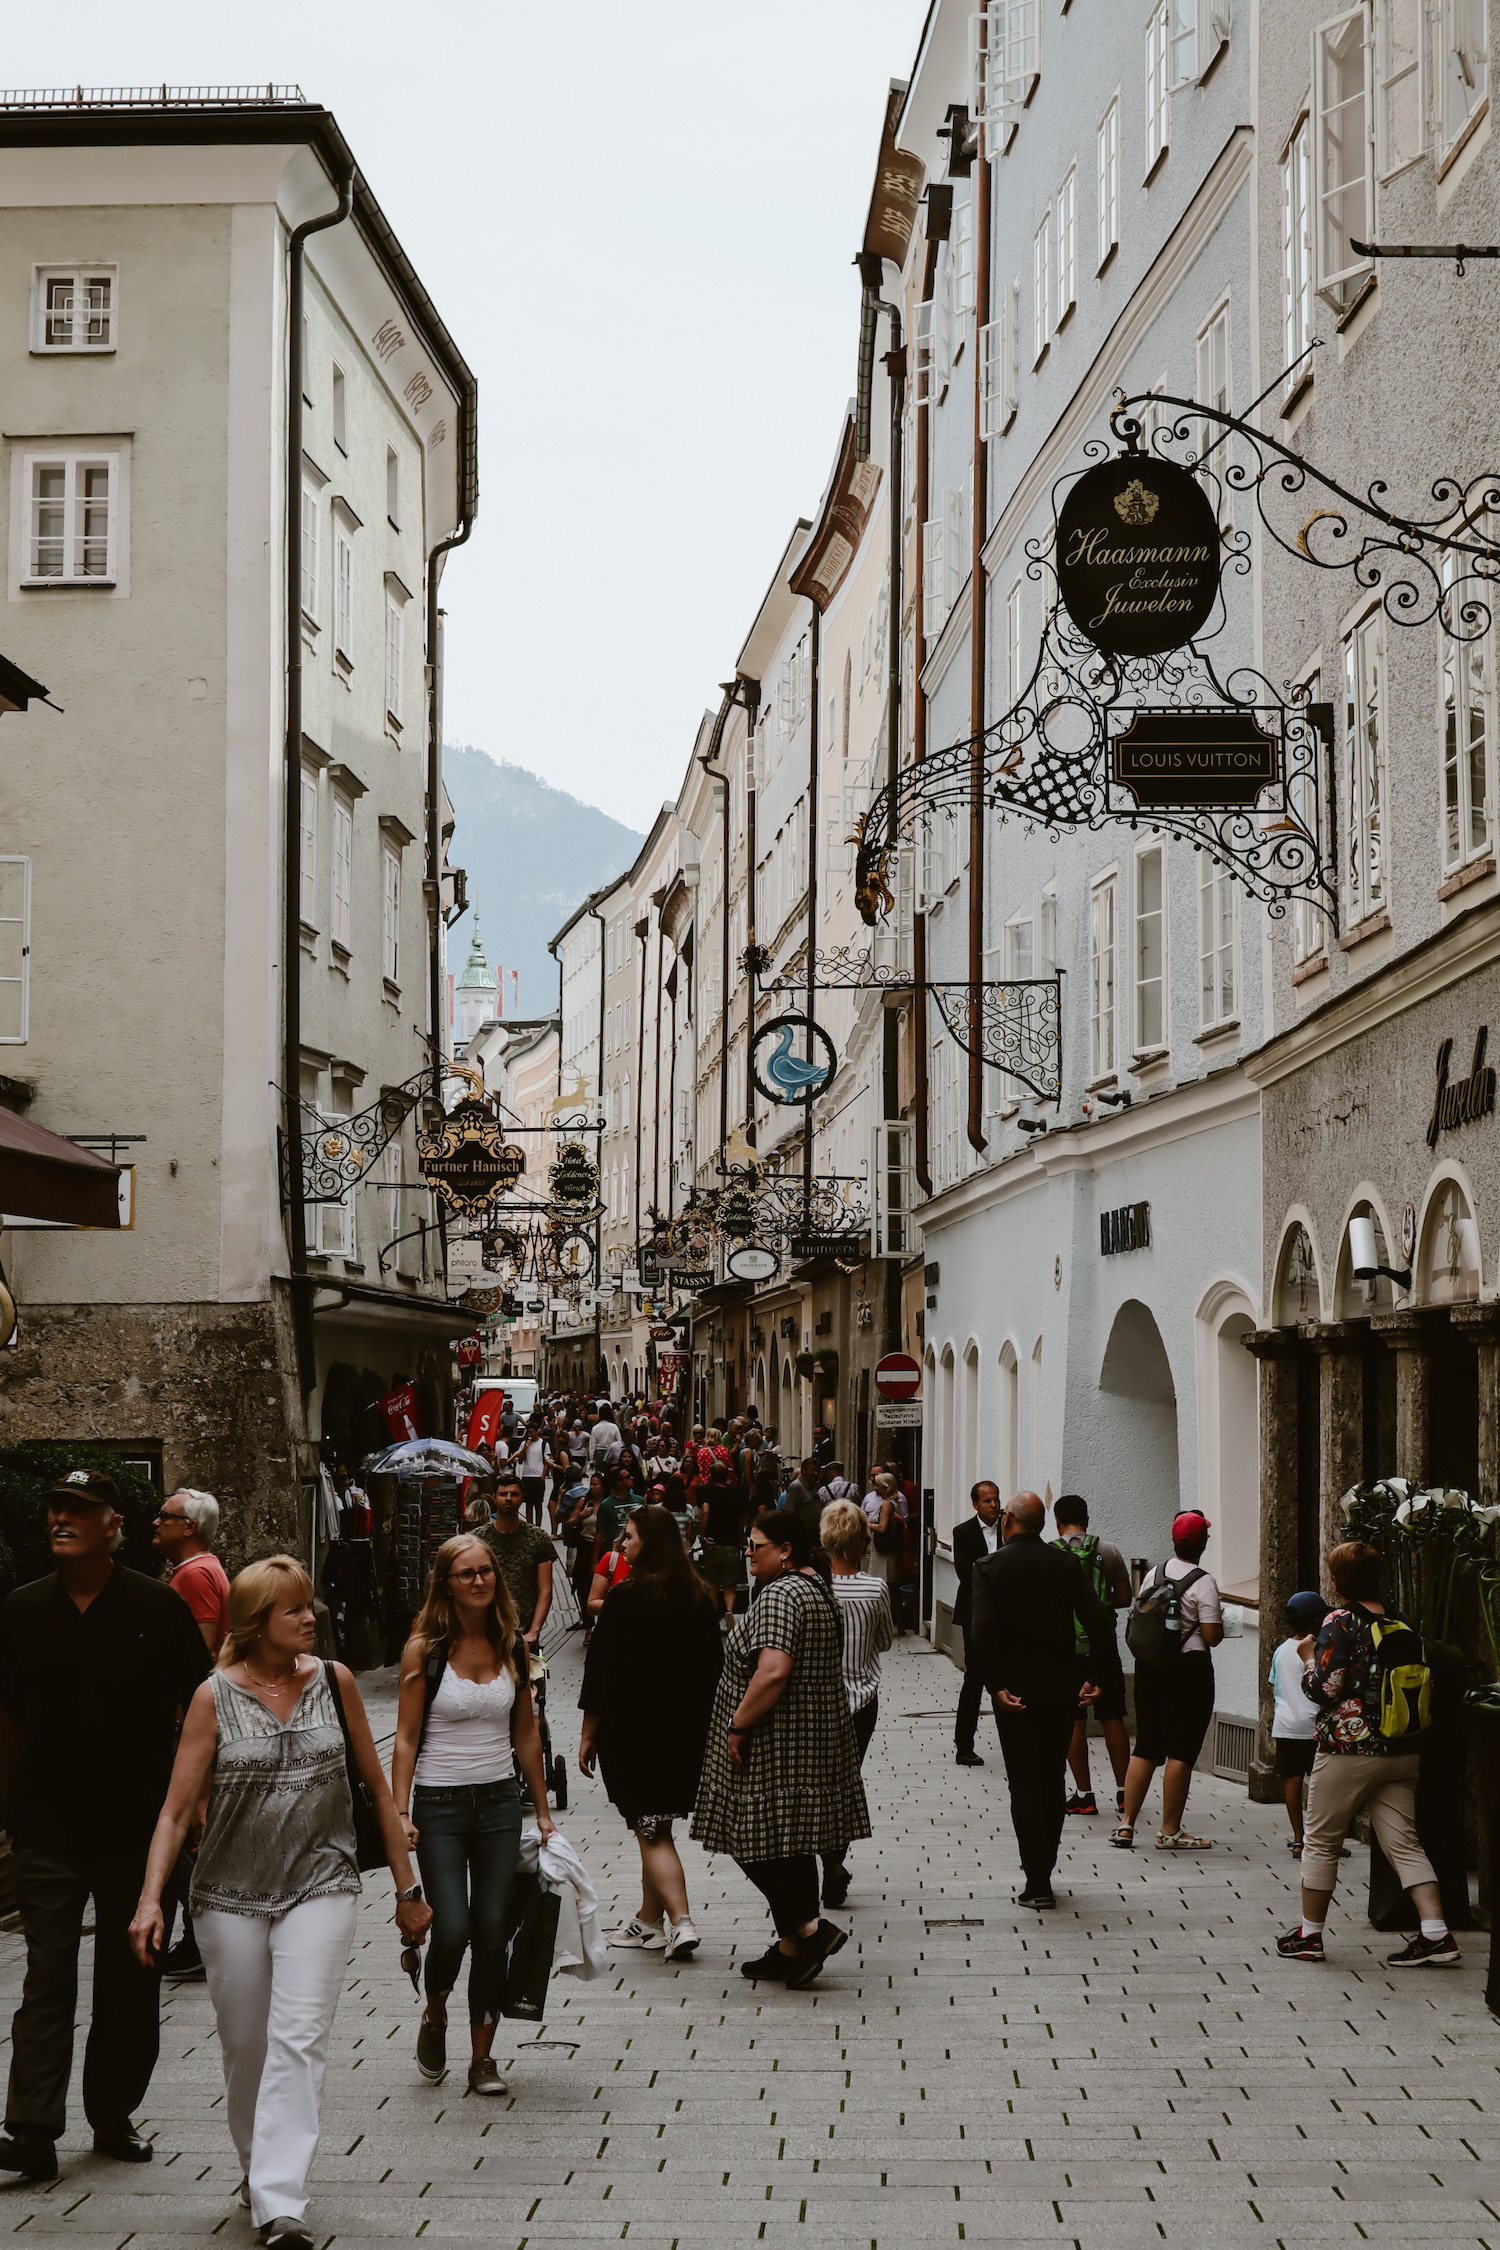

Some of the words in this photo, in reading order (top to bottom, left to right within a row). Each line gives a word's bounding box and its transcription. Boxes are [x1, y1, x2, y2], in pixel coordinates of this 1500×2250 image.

[371, 318, 407, 365] 1407
[403, 370, 434, 416] 1972
[1065, 527, 1210, 567] Haasmann
[822, 542, 848, 581] GOLDENER
[1128, 568, 1200, 590] Exclusiv
[1089, 583, 1194, 629] Juwelen
[1131, 752, 1182, 768] LOUIS
[1186, 752, 1261, 768] VUITTON
[1426, 1025, 1497, 1147] Juwelen
[423, 1160, 469, 1172] Furtner
[472, 1160, 520, 1172] Hanisch
[564, 1156, 584, 1165] Hotel
[559, 1170, 589, 1179] Goldener
[563, 1183, 587, 1192] Hirsch
[731, 1200, 748, 1208] Hotel
[796, 1245, 856, 1255] SPIRITUOSEN
[451, 1260, 478, 1268] philoro
[673, 1275, 712, 1286] STASSNY
[461, 1340, 479, 1349] EIS
